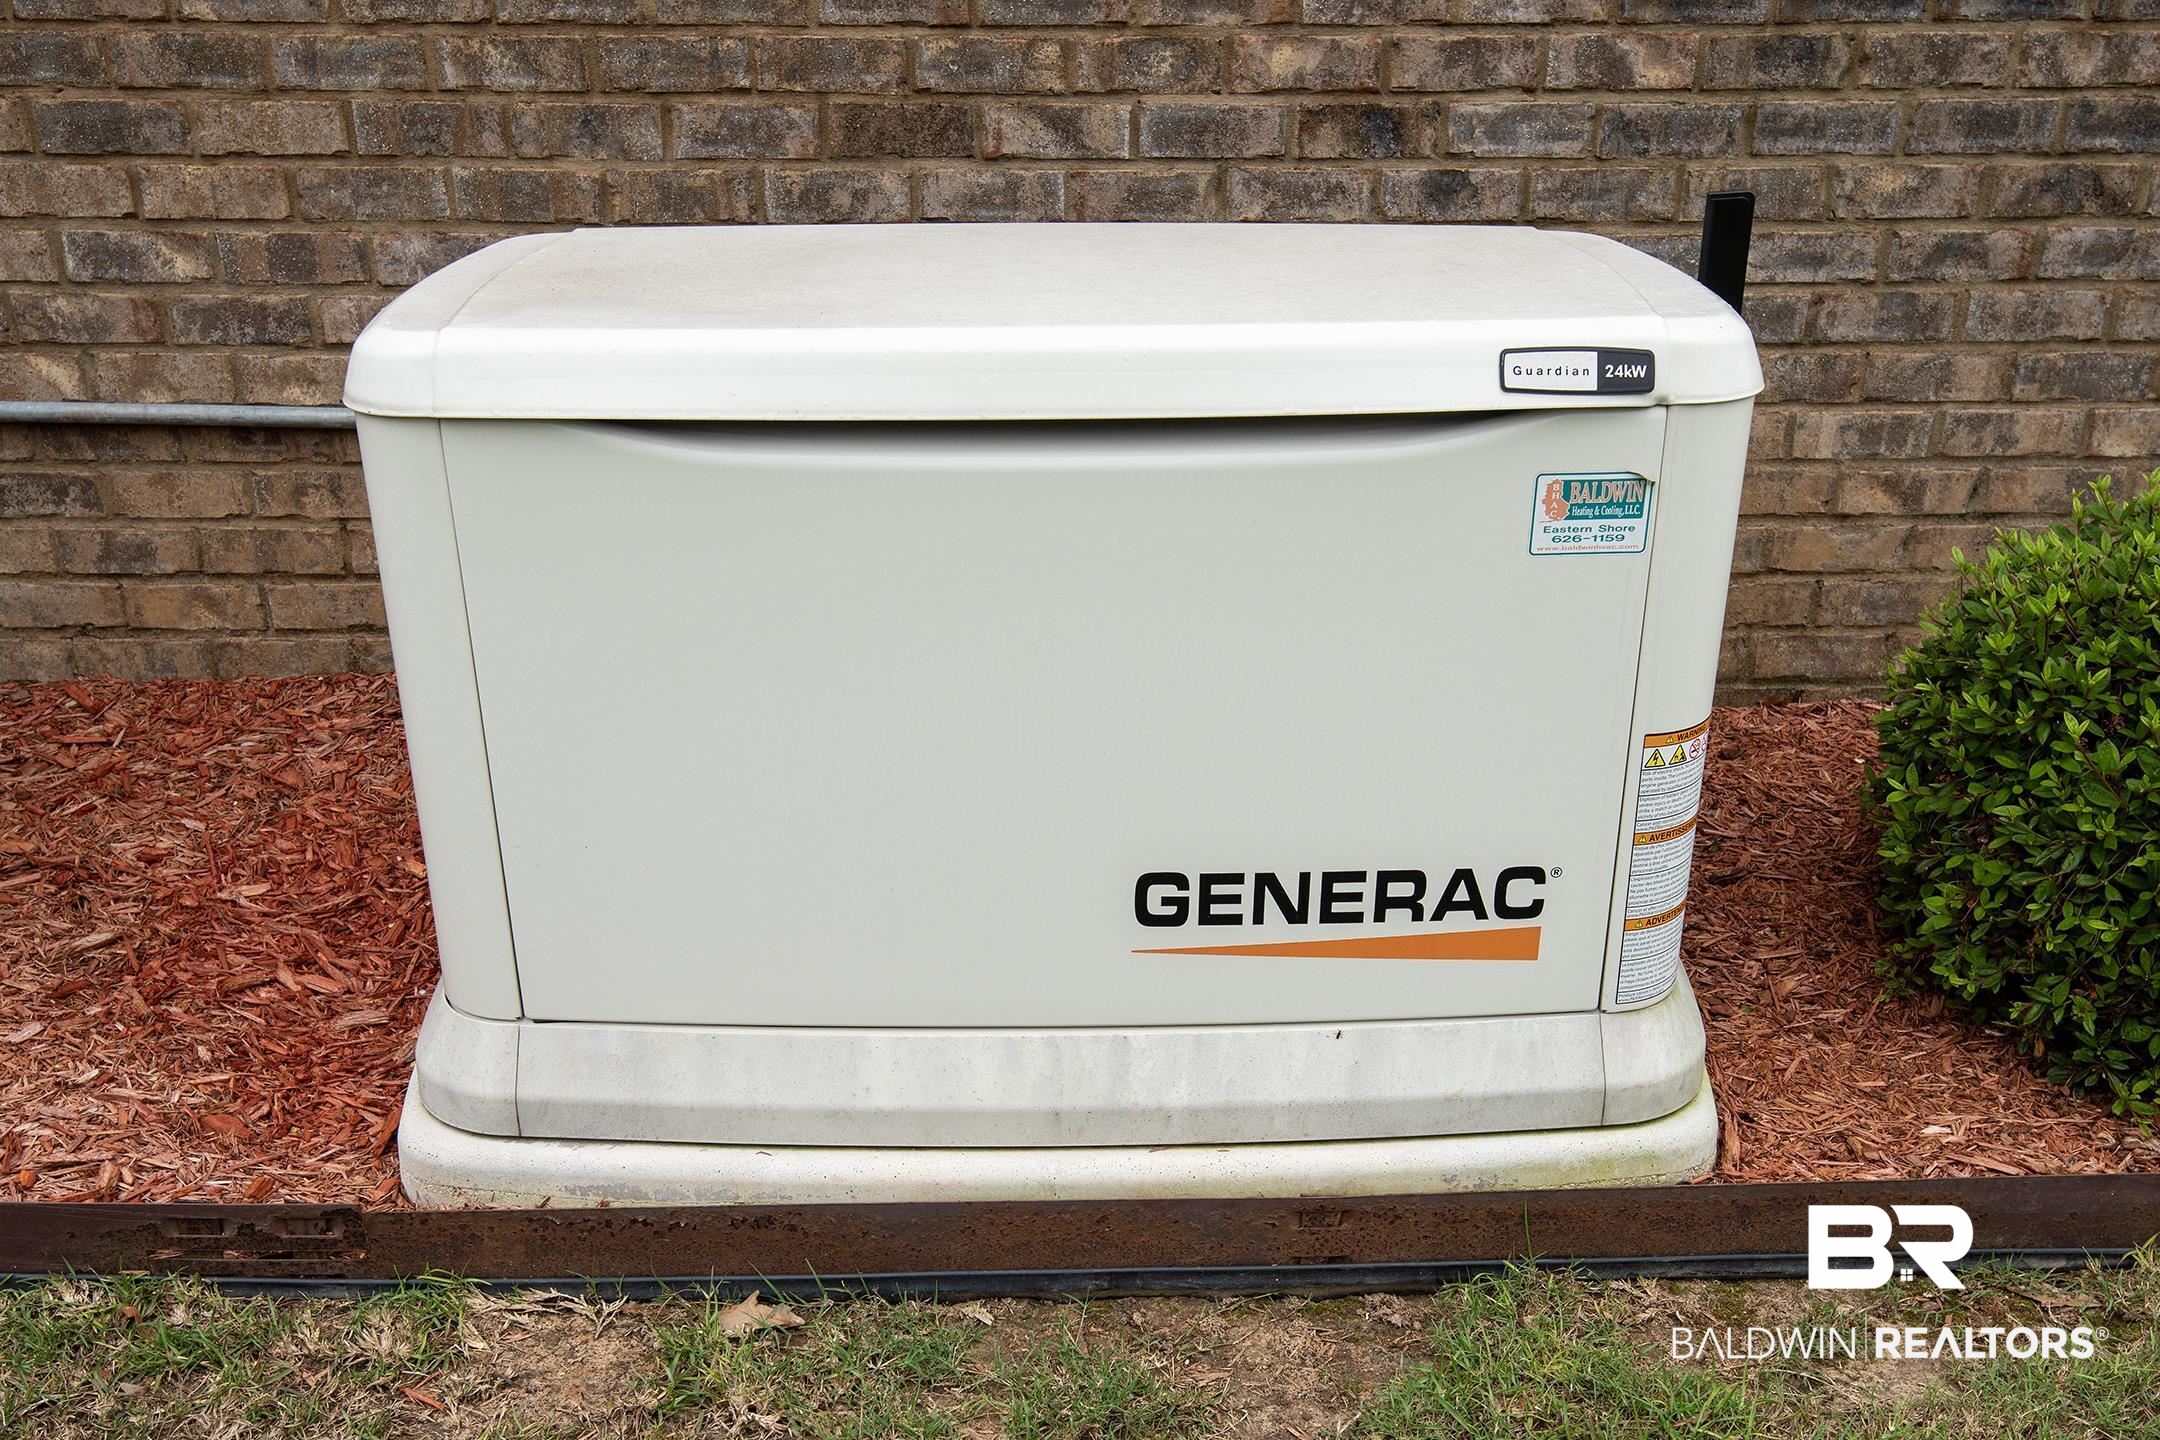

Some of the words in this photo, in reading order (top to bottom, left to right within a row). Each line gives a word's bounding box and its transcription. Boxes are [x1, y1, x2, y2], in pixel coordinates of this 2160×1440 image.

[1512, 365, 1590, 376] Guardian
[1602, 364, 1648, 379] 24kW
[1569, 480, 1645, 504] BALDWIN
[1571, 506, 1594, 518] Heating
[1594, 506, 1600, 515] &
[1543, 525, 1592, 534] Eastern
[1598, 524, 1636, 533] Shore
[1552, 534, 1626, 544] 626-1159
[1536, 544, 1639, 552] www.baldwinhvac.com
